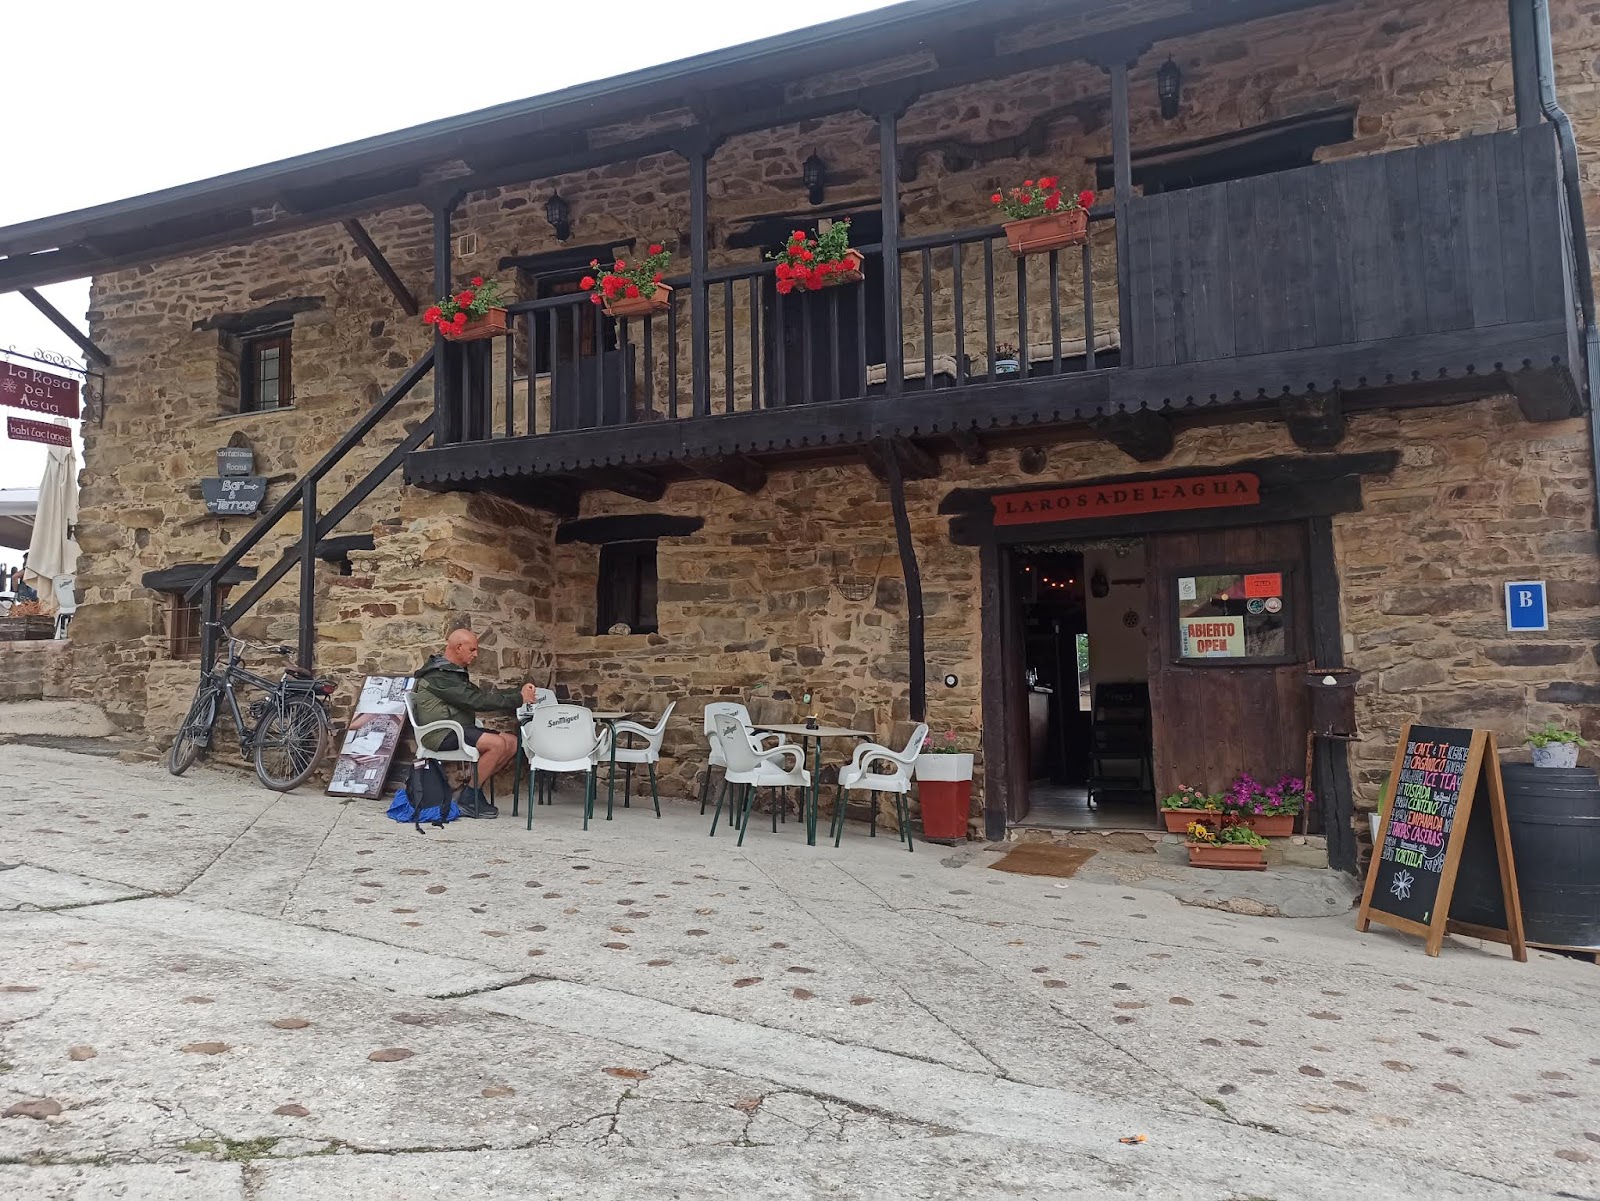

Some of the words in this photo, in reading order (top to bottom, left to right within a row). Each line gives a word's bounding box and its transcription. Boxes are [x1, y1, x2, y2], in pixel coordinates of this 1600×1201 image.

[8, 364, 28, 379] La
[33, 370, 71, 390] Rosa
[221, 479, 245, 491] Bar
[216, 498, 257, 510] Terrace
[1518, 590, 1533, 608] B
[1188, 622, 1235, 638] ABIERTO
[1197, 639, 1228, 654] OPEN
[1413, 741, 1434, 757] CAFÉ
[1422, 771, 1439, 787] ICE
[1440, 773, 1457, 791] TEA
[1403, 783, 1431, 800] TOSTADA
[1407, 799, 1439, 815] CENTENO
[1407, 811, 1443, 832] EMPANADA
[1410, 826, 1442, 847] CASERAS
[1394, 848, 1424, 869] TORTILLA
